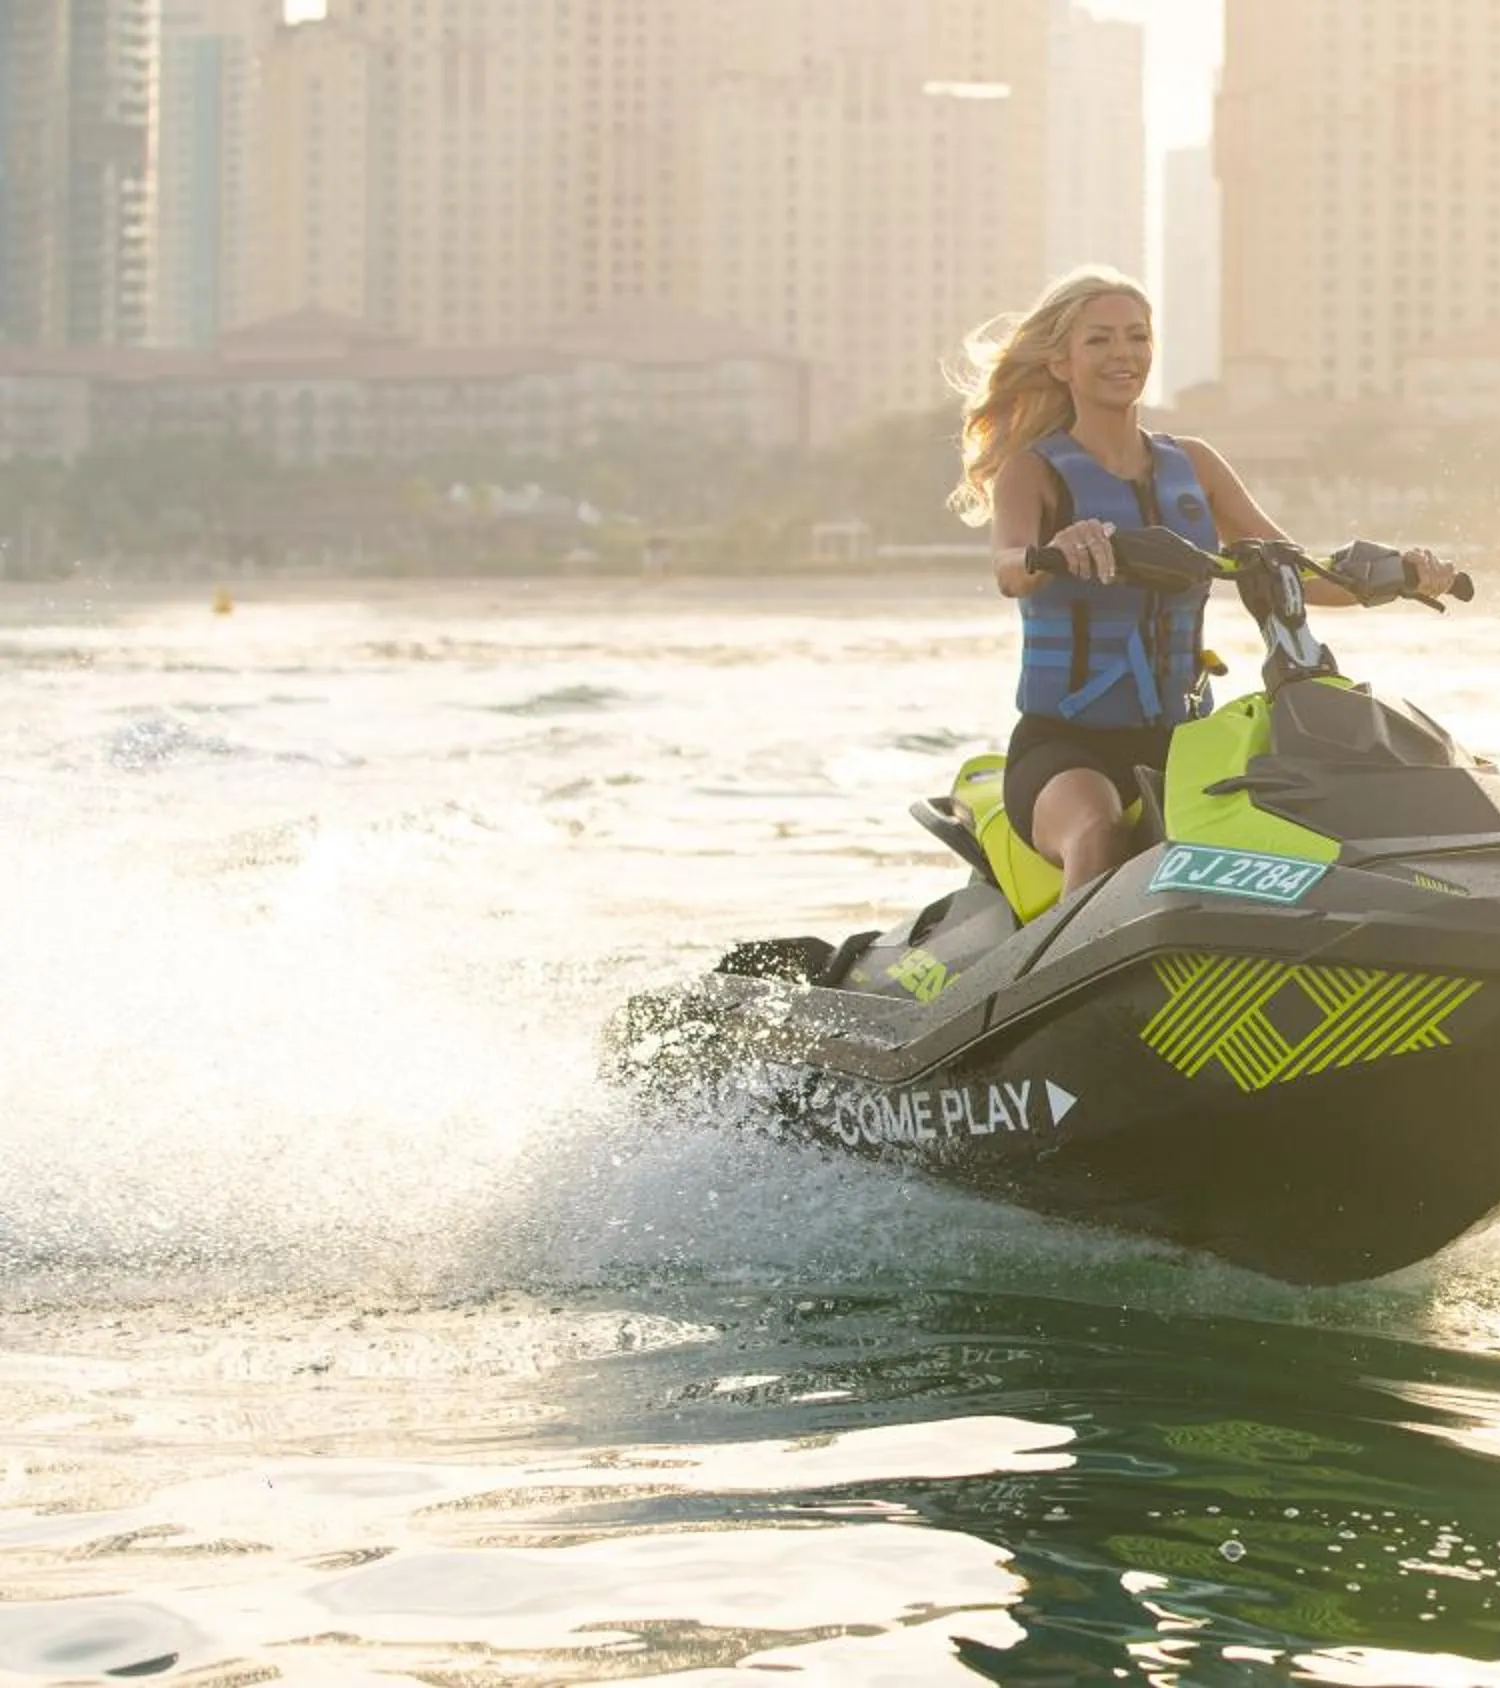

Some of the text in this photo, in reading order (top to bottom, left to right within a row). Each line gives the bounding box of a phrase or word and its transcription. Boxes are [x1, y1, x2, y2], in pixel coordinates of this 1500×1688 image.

[1216, 858, 1312, 894] 2784
[834, 1079, 1031, 1146] COME PLAY
